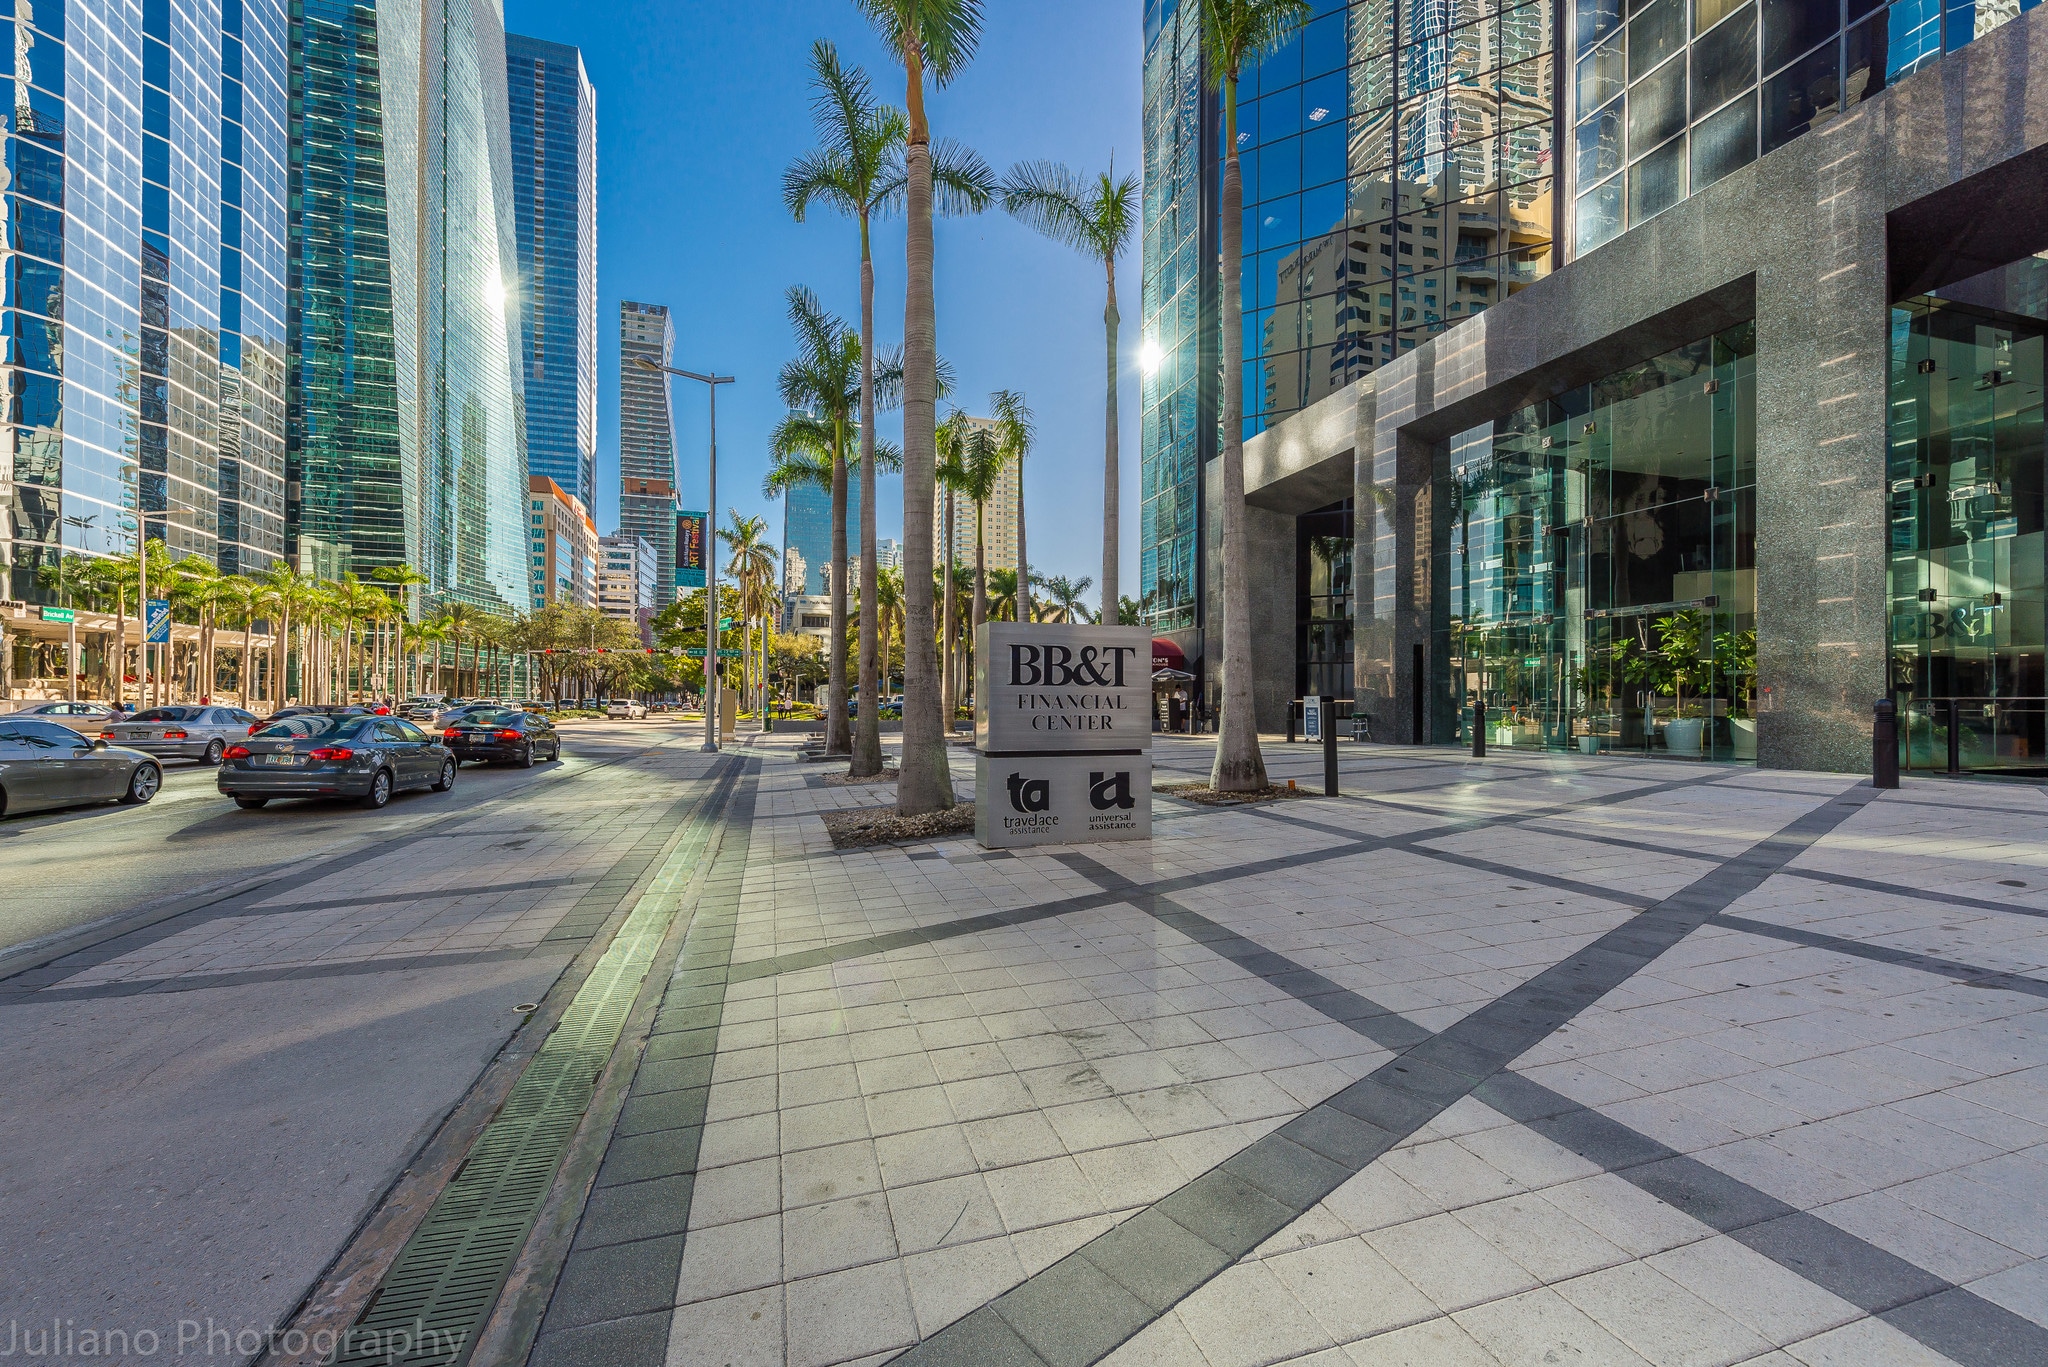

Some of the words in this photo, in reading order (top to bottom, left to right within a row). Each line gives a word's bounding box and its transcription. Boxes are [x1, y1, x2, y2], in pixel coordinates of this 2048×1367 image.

[689, 516, 700, 549] Festival
[689, 550, 699, 569] ART
[43, 610, 65, 618] Brickell
[1006, 644, 1136, 687] BB&T
[1018, 694, 1128, 710] FINANCIAL
[1032, 714, 1113, 731] CENTER
[1089, 812, 1132, 823] universal
[1009, 826, 1050, 835] assistance
[1089, 821, 1137, 831] assistance
